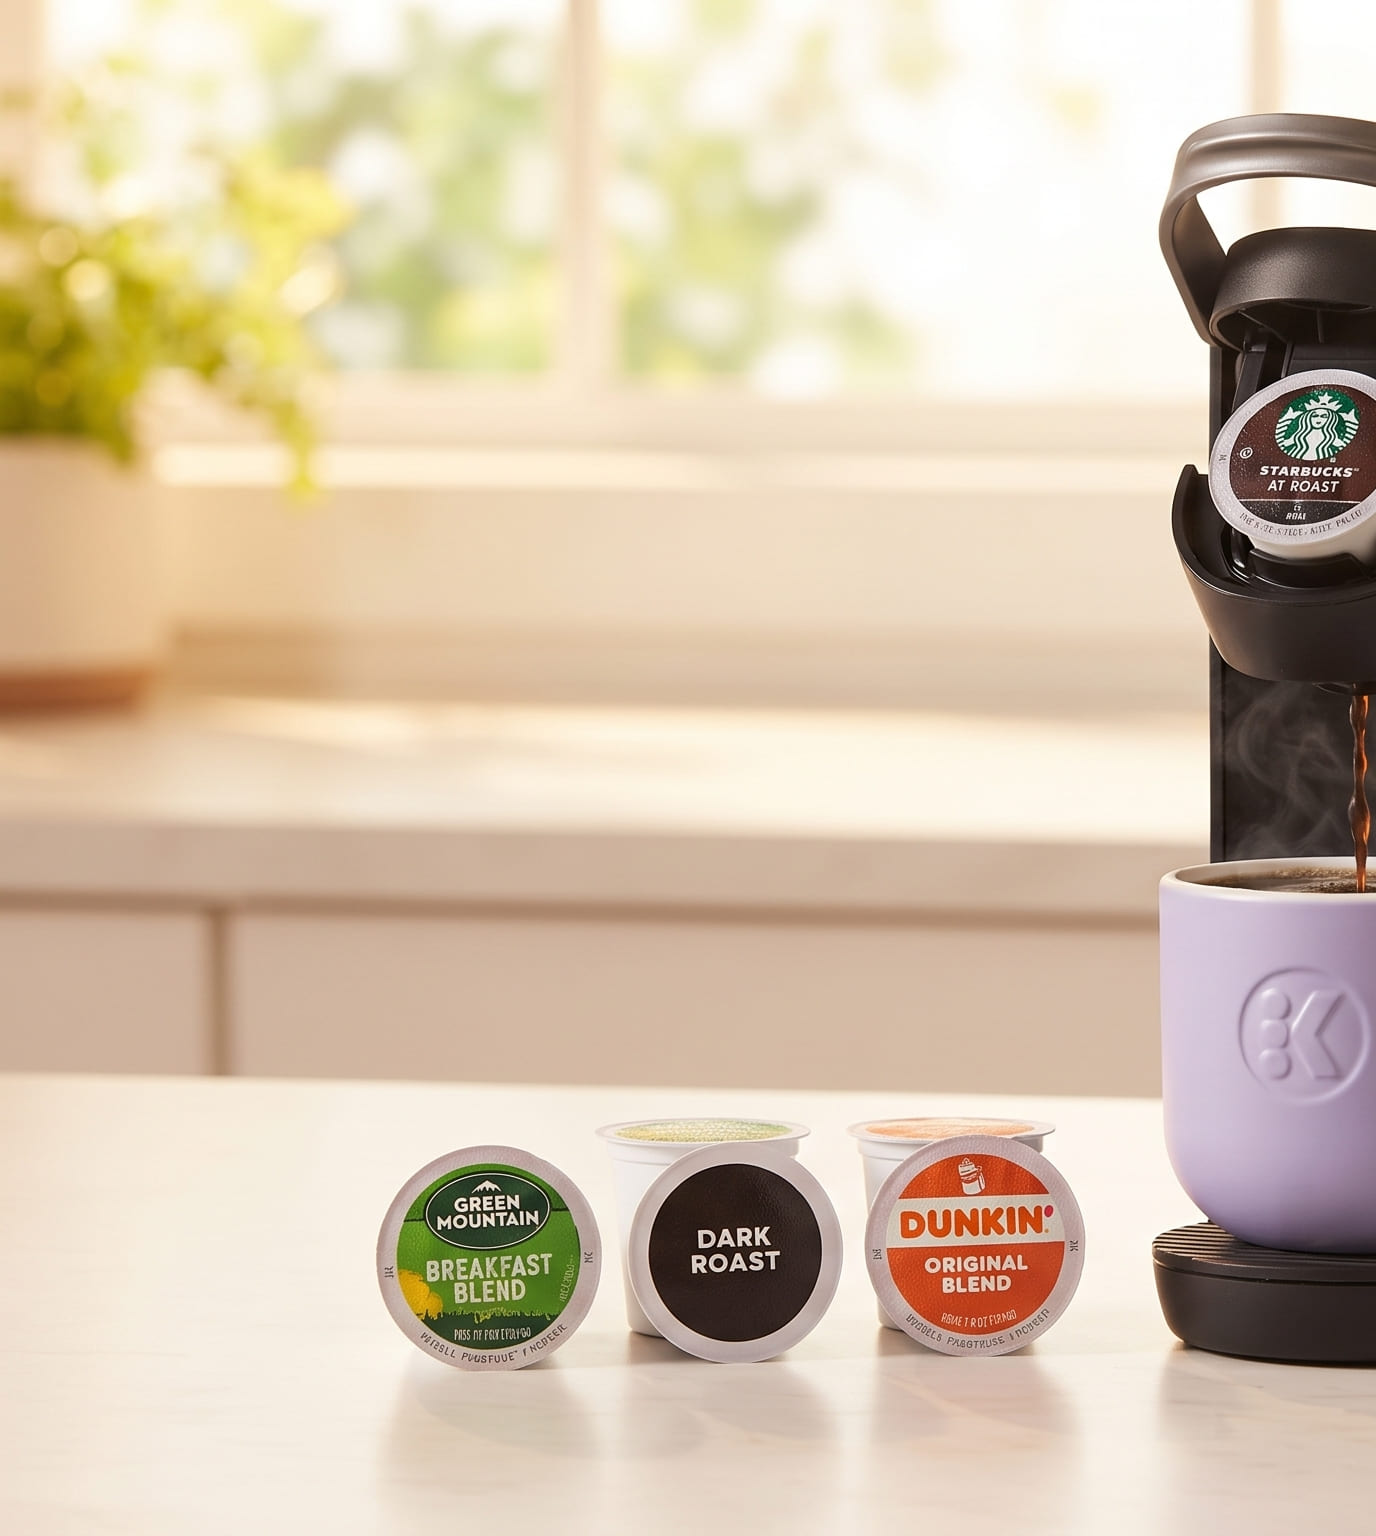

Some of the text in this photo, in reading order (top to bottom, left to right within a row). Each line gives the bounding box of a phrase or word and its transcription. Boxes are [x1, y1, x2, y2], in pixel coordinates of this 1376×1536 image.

[1259, 465, 1353, 478] STARBUCKS
[1267, 480, 1340, 493] AT ROAST
[454, 1194, 521, 1213] GREEN
[436, 1210, 539, 1231] MOUNTAIN
[899, 1204, 1054, 1239] DUNKIN'
[697, 1226, 772, 1249] DARK
[426, 1253, 553, 1282] BREAKFAST
[690, 1250, 781, 1274] ROAST
[924, 1254, 1029, 1274] ORIGINAL
[454, 1278, 526, 1304] BLEND
[942, 1275, 1012, 1294] BLEND
